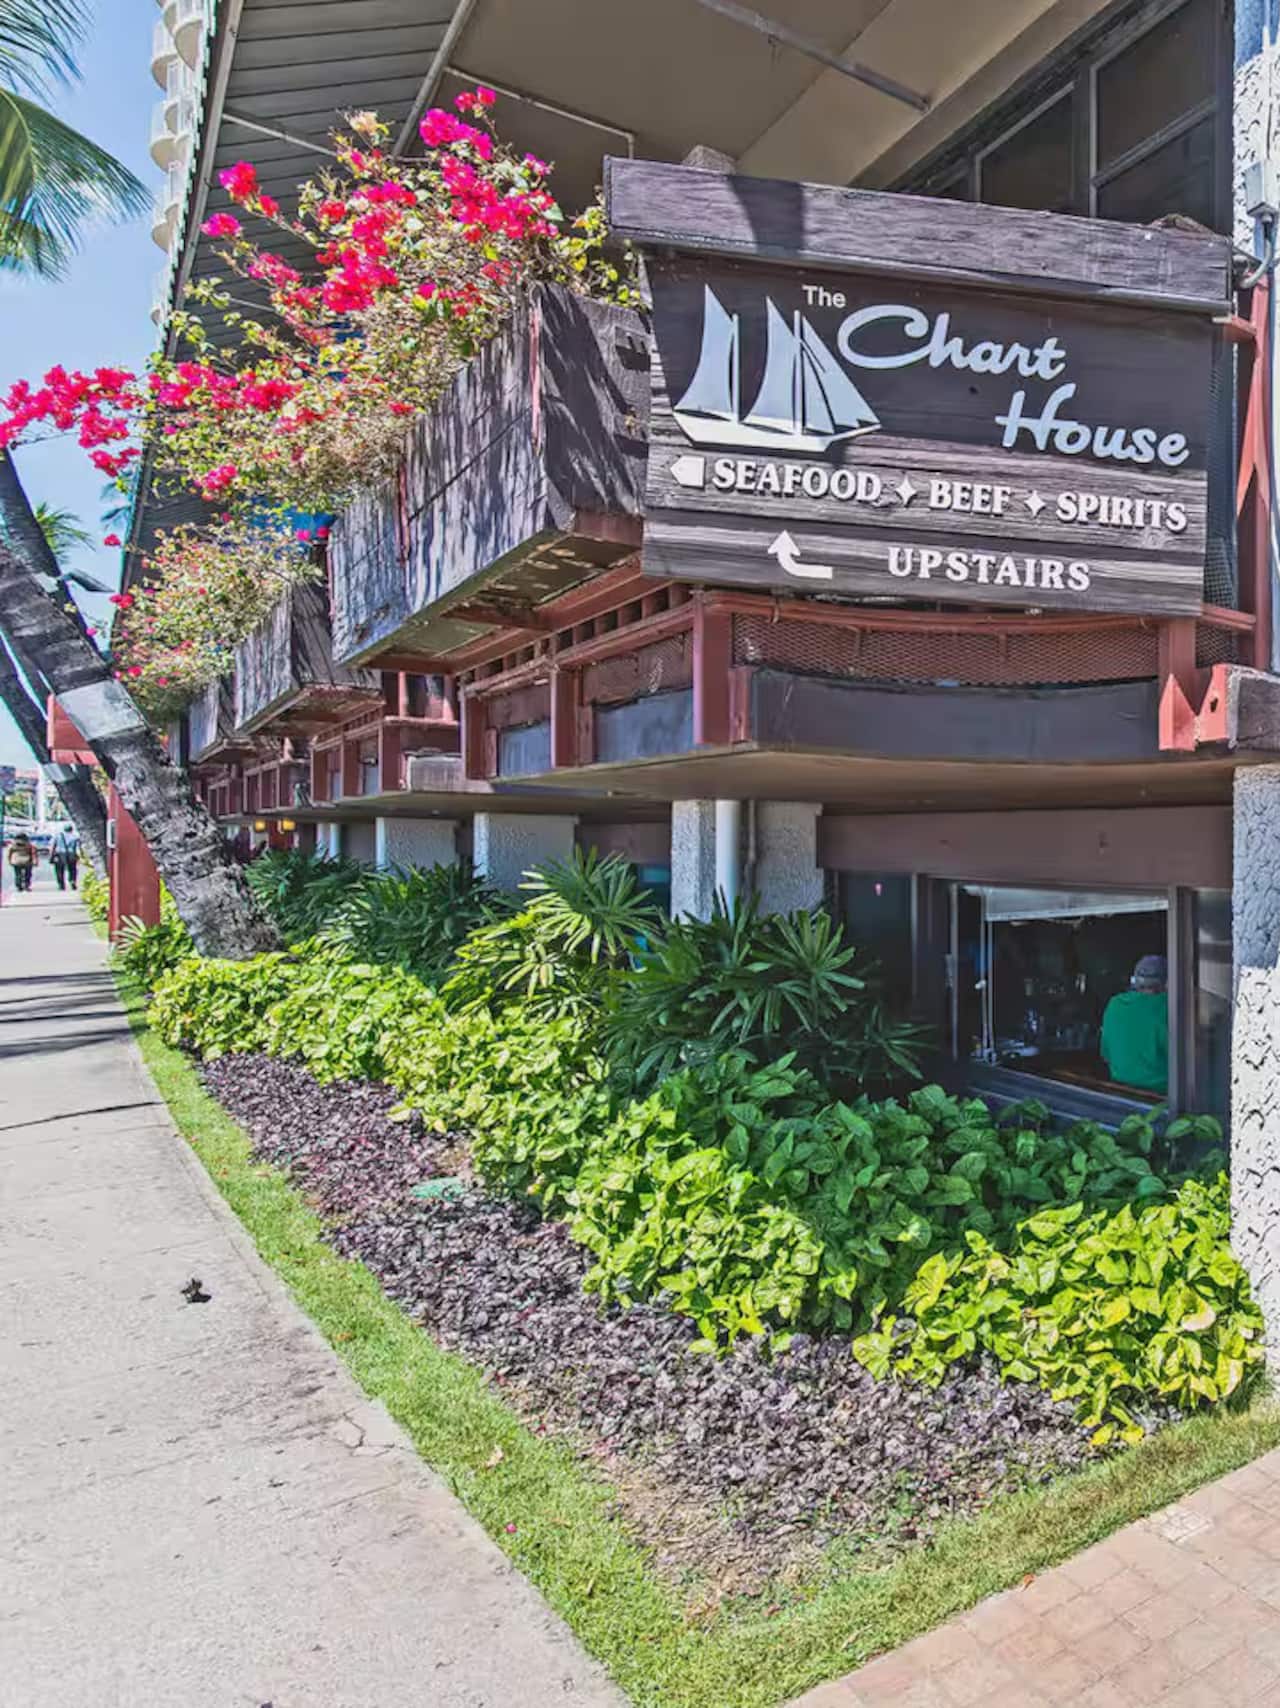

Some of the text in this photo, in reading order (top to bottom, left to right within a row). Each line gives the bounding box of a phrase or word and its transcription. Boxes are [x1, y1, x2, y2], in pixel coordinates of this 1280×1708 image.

[803, 285, 846, 309] The
[837, 303, 1066, 381] Chart
[995, 383, 1190, 467] House
[712, 459, 1188, 532] SEAFOOD BEEF SPIRITS
[887, 546, 1090, 592] UPSTAIRS
